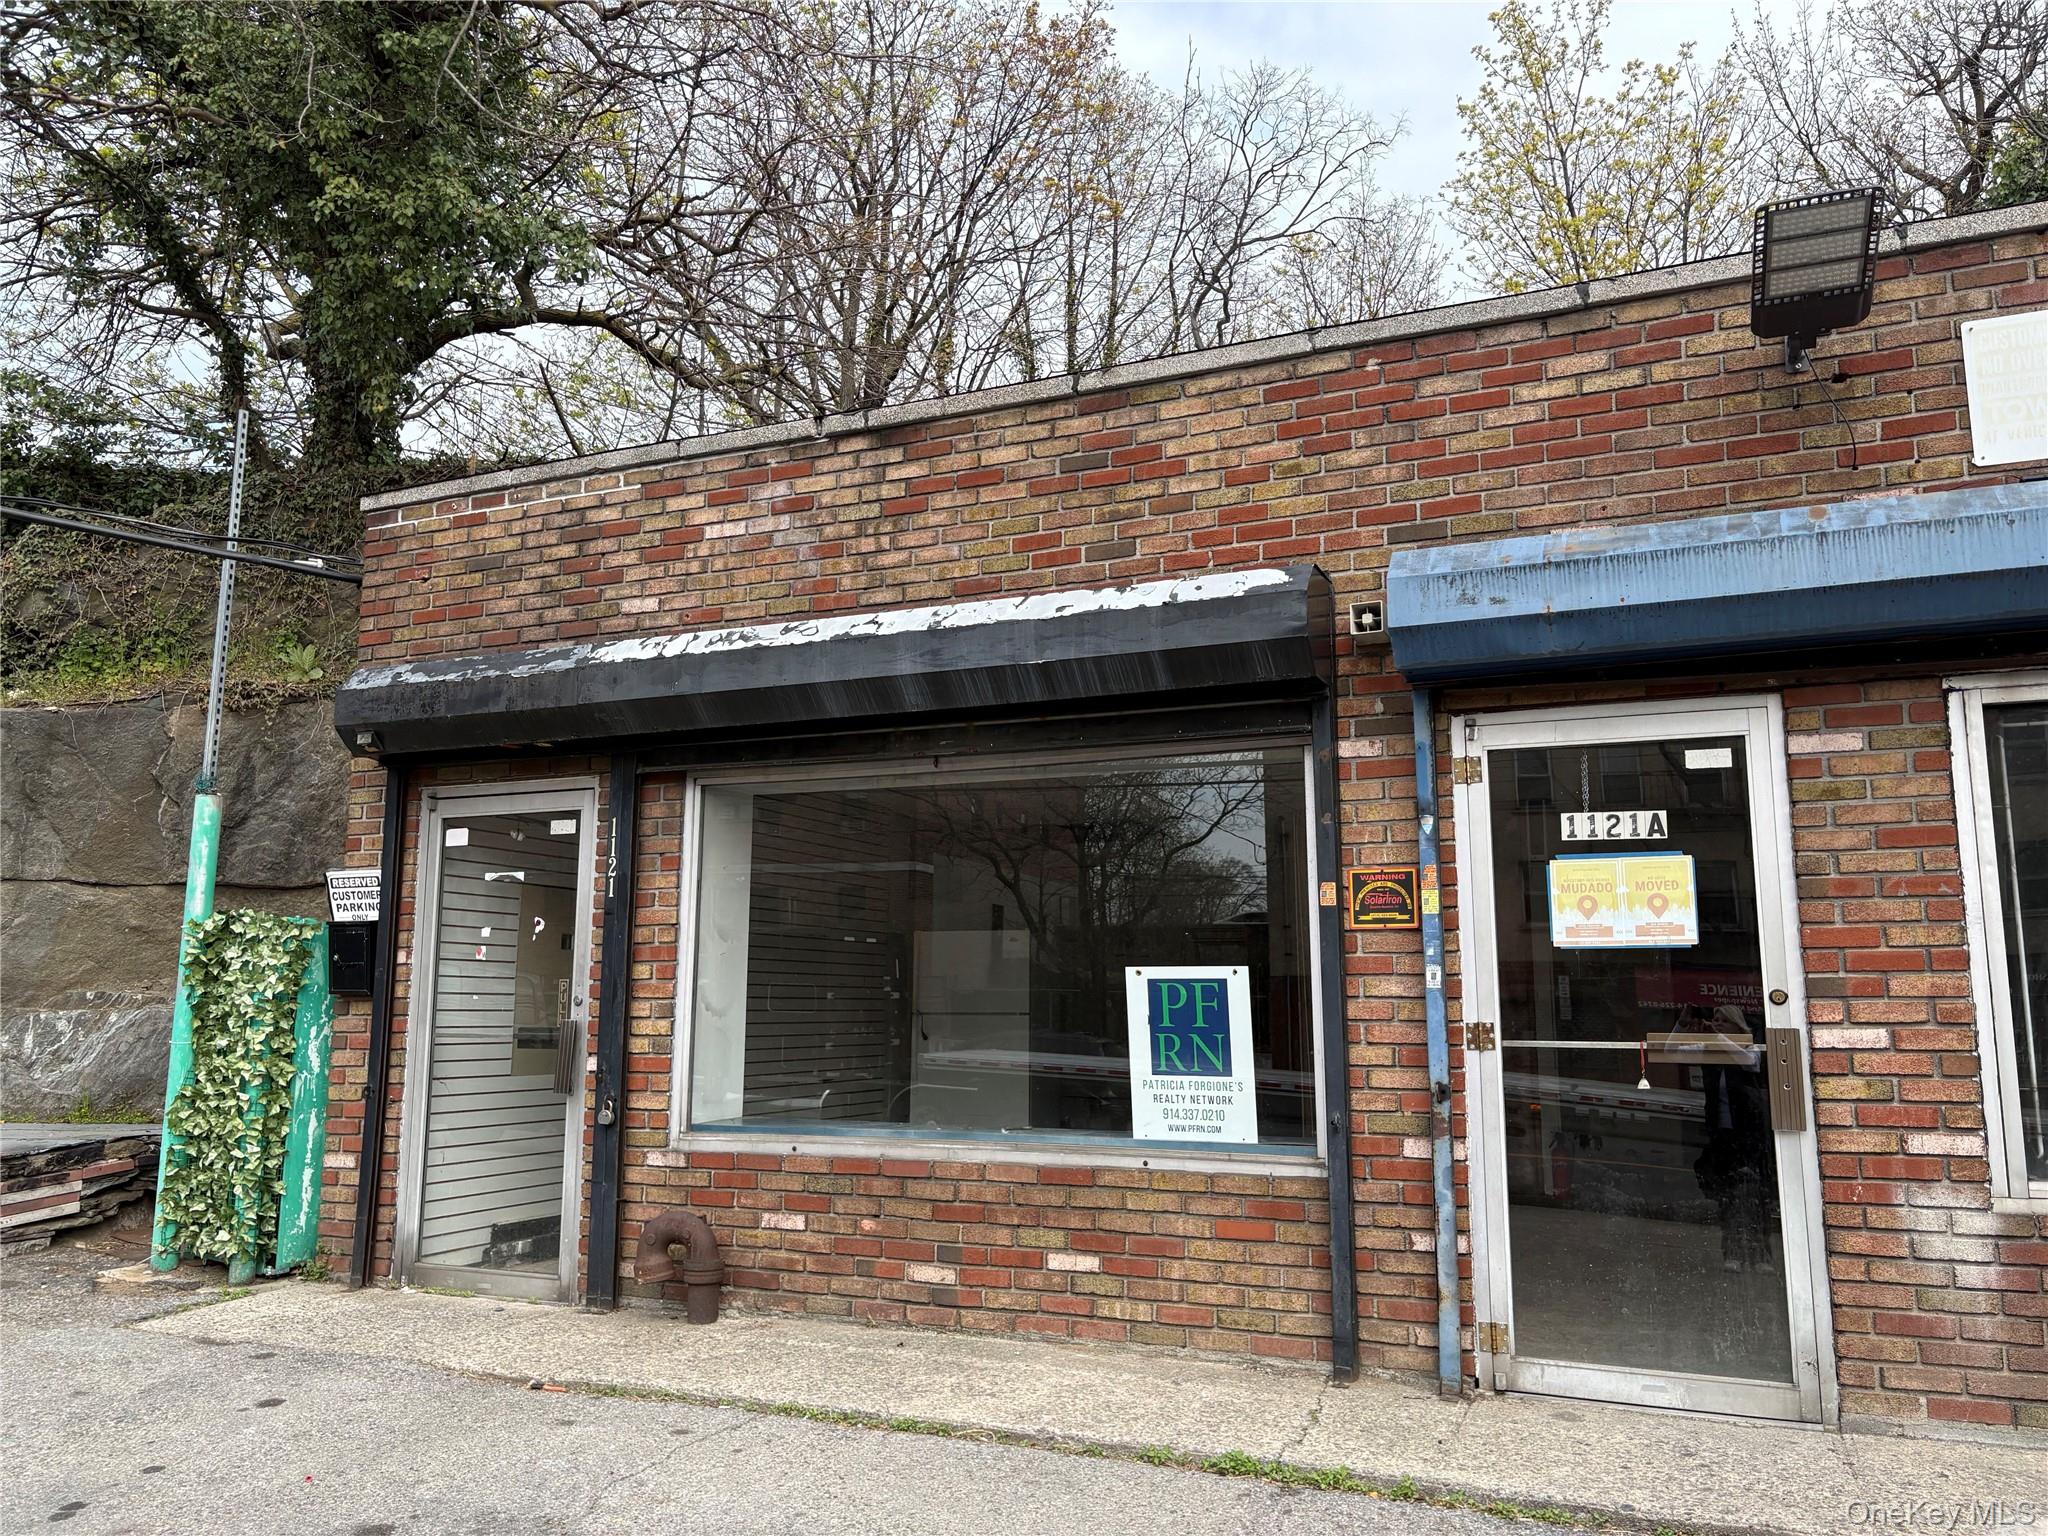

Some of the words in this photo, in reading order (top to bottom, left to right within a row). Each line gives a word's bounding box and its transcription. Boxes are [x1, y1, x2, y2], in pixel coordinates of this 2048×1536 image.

[1566, 812, 1667, 839] 1121A
[608, 816, 617, 898] 1121
[332, 876, 379, 888] RESERVED
[1360, 873, 1406, 881] WARNING
[1560, 882, 1613, 894] MUDADO
[1635, 879, 1680, 892] MOVED
[1142, 1079, 1185, 1091] PATRICIA
[1188, 1080, 1244, 1093] FORGIONE'S
[1153, 1093, 1187, 1104] REALTY
[1190, 1094, 1234, 1106] NETWORK
[1162, 1107, 1226, 1122] 914.337.0210
[1167, 1124, 1222, 1134] WWW.PFRN.COM
